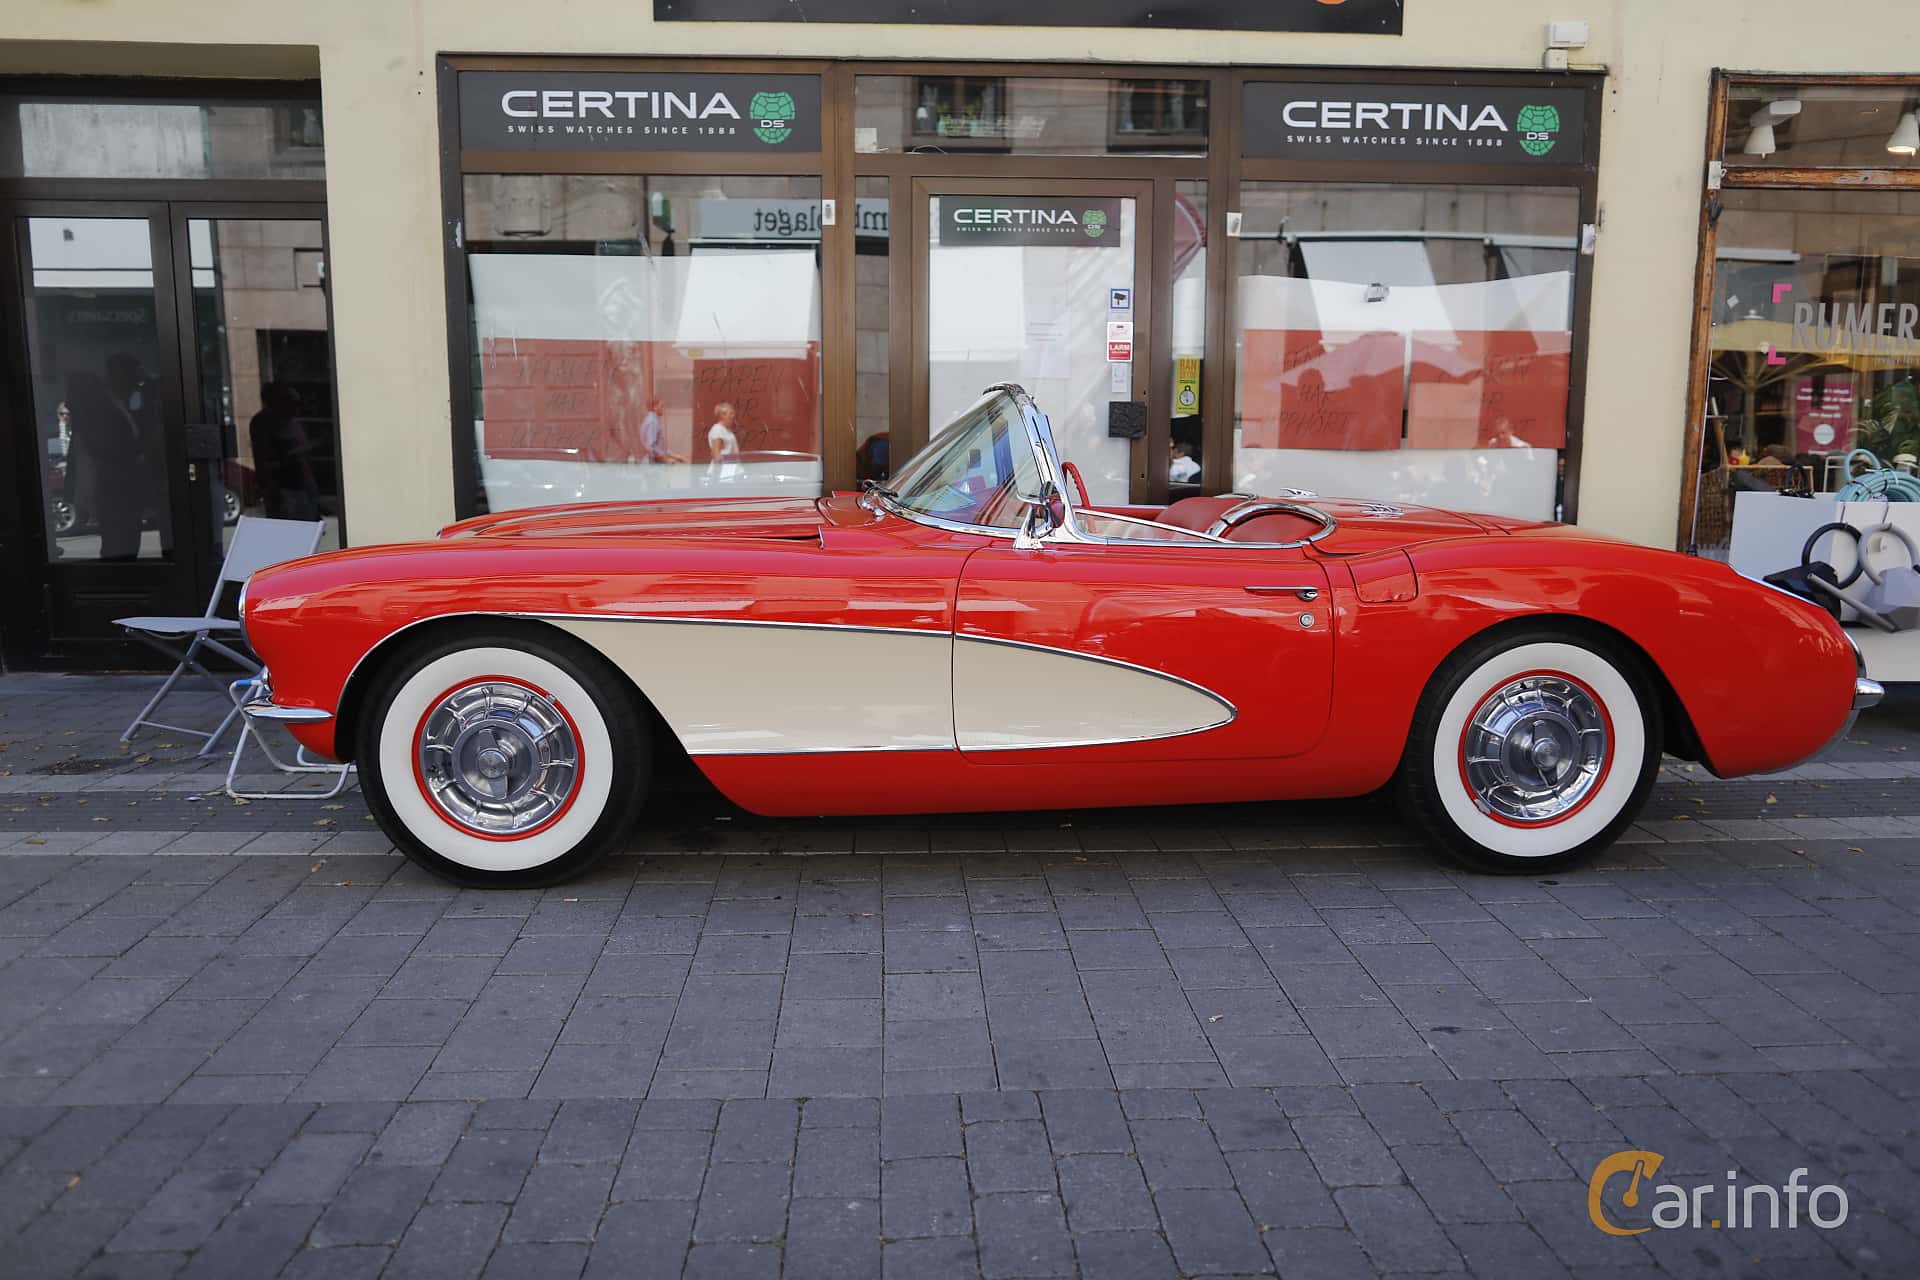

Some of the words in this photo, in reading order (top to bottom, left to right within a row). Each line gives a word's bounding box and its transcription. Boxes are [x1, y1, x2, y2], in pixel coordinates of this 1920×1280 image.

[501, 90, 741, 120] CERTINA
[1282, 101, 1508, 132] CERTINA
[507, 125, 556, 134] SWISS
[565, 125, 634, 135] WATCHES
[644, 126, 690, 135] SINCE
[698, 126, 737, 136] 1888
[760, 119, 785, 129] DS
[1287, 135, 1332, 144] SWISS
[1342, 135, 1408, 145] WATCHES
[1416, 136, 1459, 146] SINCE
[1467, 138, 1504, 147] 1888
[1525, 131, 1550, 141] DS
[953, 208, 1078, 225] CERTINA
[1791, 302, 1919, 349] RUMER
